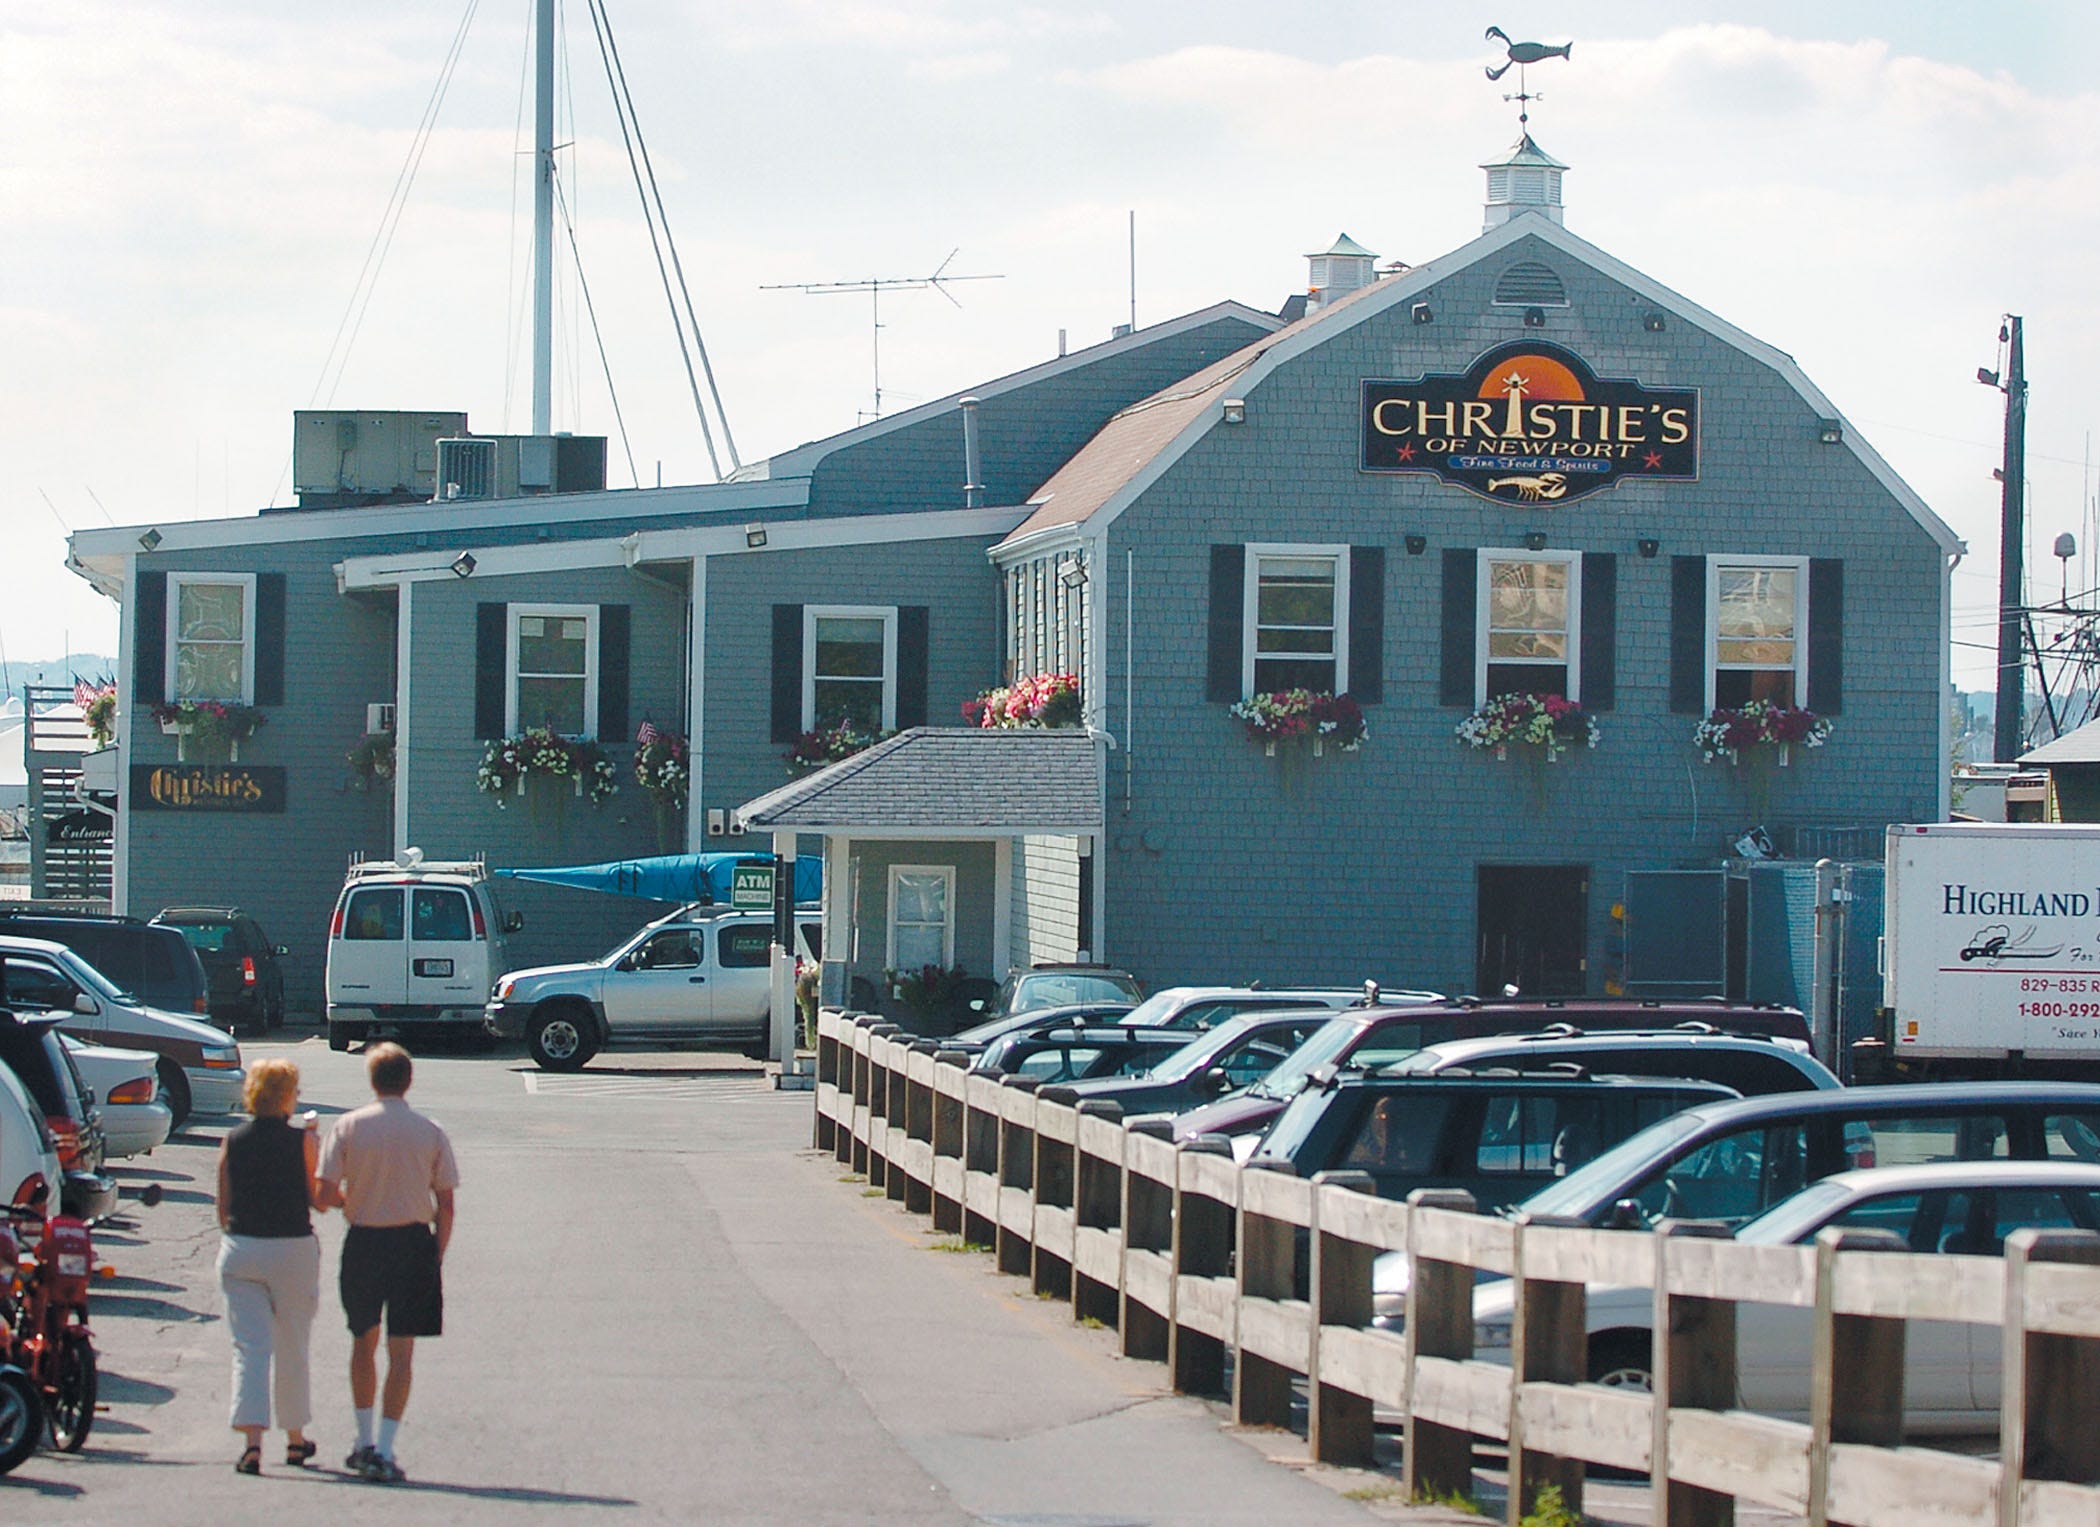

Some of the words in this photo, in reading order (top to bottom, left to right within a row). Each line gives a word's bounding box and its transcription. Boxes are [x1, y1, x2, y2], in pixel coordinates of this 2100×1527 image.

[1373, 397, 1689, 444] CHRISTIE'S
[1425, 437, 1468, 453] OF
[1477, 439, 1636, 459] NEWPORT
[1459, 455, 1495, 469] Fine
[1496, 456, 1537, 469] Food
[1540, 459, 1551, 470] &
[150, 767, 262, 806] Christie's
[60, 824, 113, 839] Entranc
[736, 874, 771, 889] ATM
[1942, 884, 2090, 917] HIGHLAND
[2020, 978, 2087, 993] 829-835
